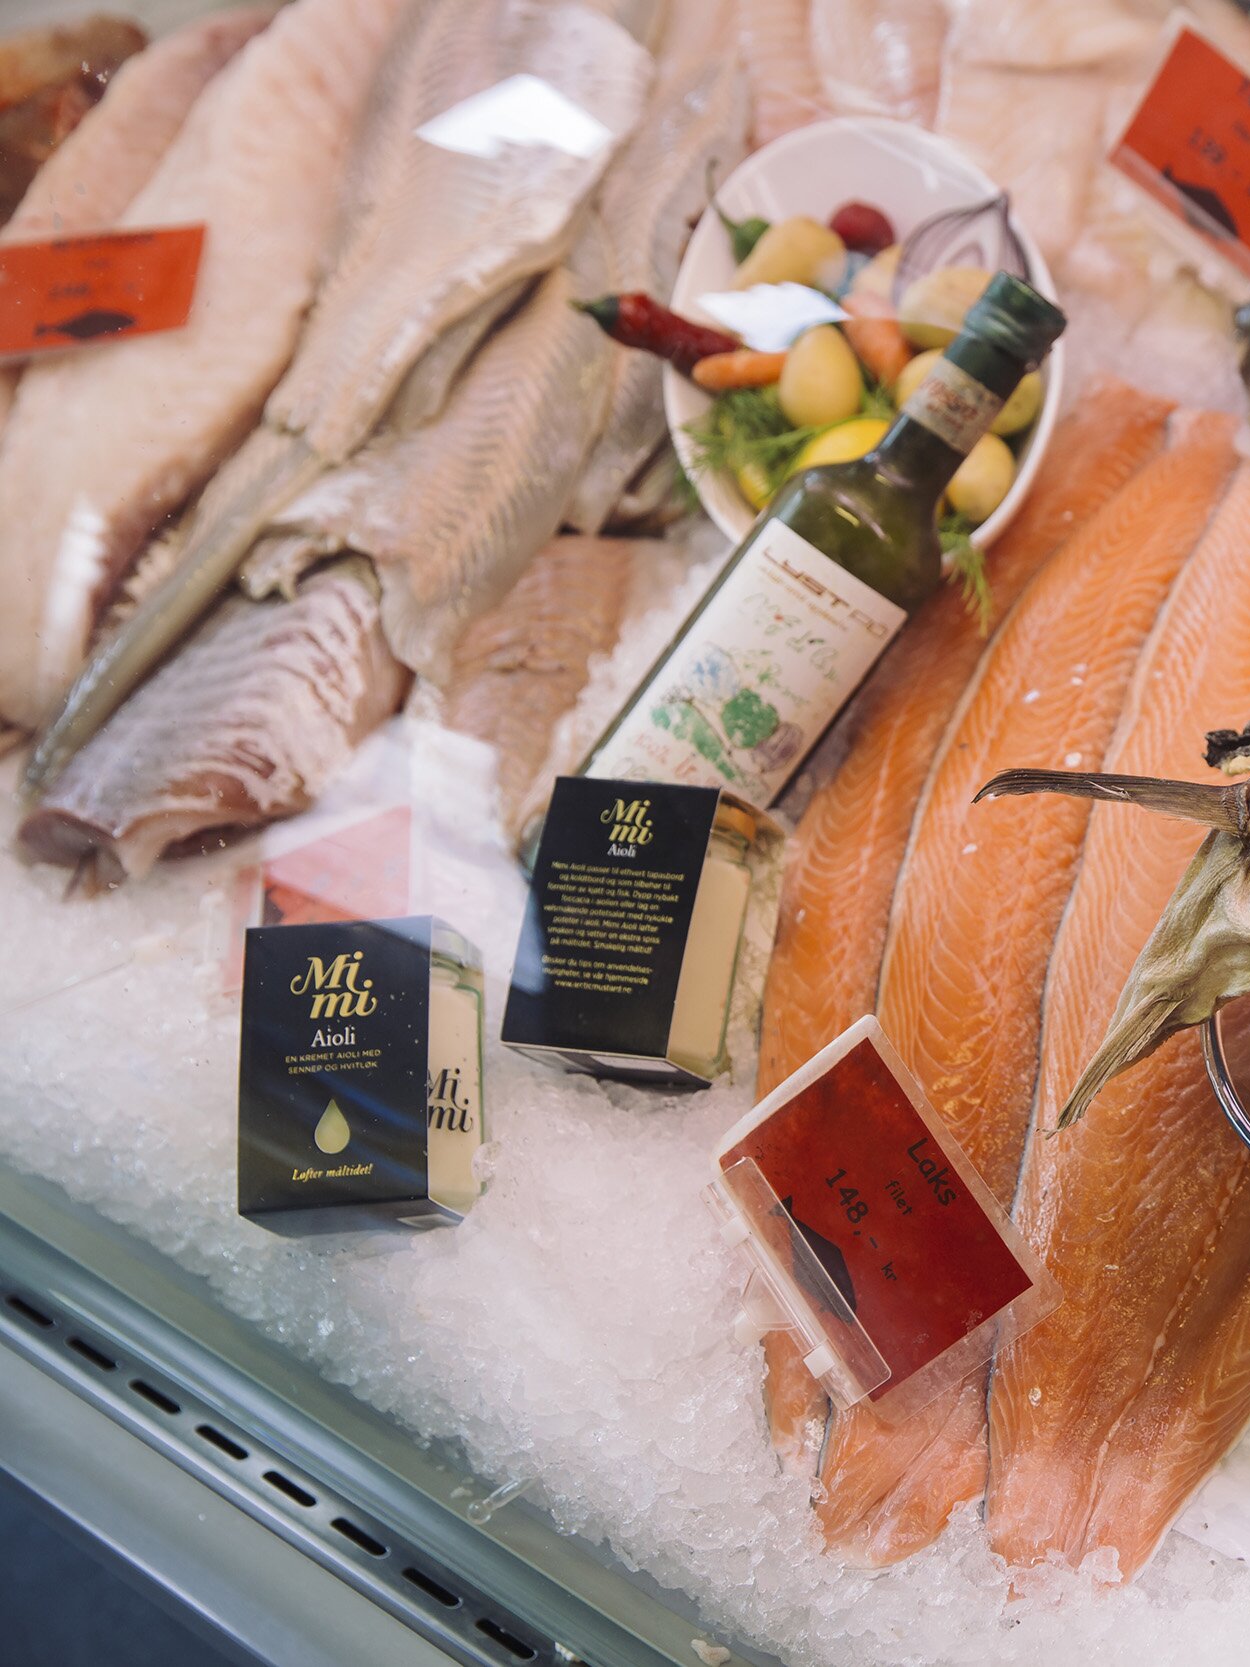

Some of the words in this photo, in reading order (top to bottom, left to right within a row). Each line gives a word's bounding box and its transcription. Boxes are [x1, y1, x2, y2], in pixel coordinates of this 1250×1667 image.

[600, 798, 652, 829] Mi
[608, 820, 654, 845] mi
[607, 843, 637, 858] Aioli
[606, 878, 615, 886] og
[290, 950, 364, 995] Mi
[309, 980, 378, 1020] mi
[311, 1027, 356, 1047] Aioli
[285, 1055, 297, 1063] EN
[300, 1053, 334, 1062] KREMET
[336, 1051, 360, 1060] AIOLI
[362, 1049, 381, 1057] MED
[288, 1065, 322, 1074] SENNEP
[325, 1063, 338, 1072] OG
[340, 1061, 378, 1071] HVITLØK
[325, 1163, 373, 1178] måltidet!
[907, 1137, 957, 1206] Laks
[885, 1180, 913, 1216] filet
[881, 1262, 897, 1282] kr
